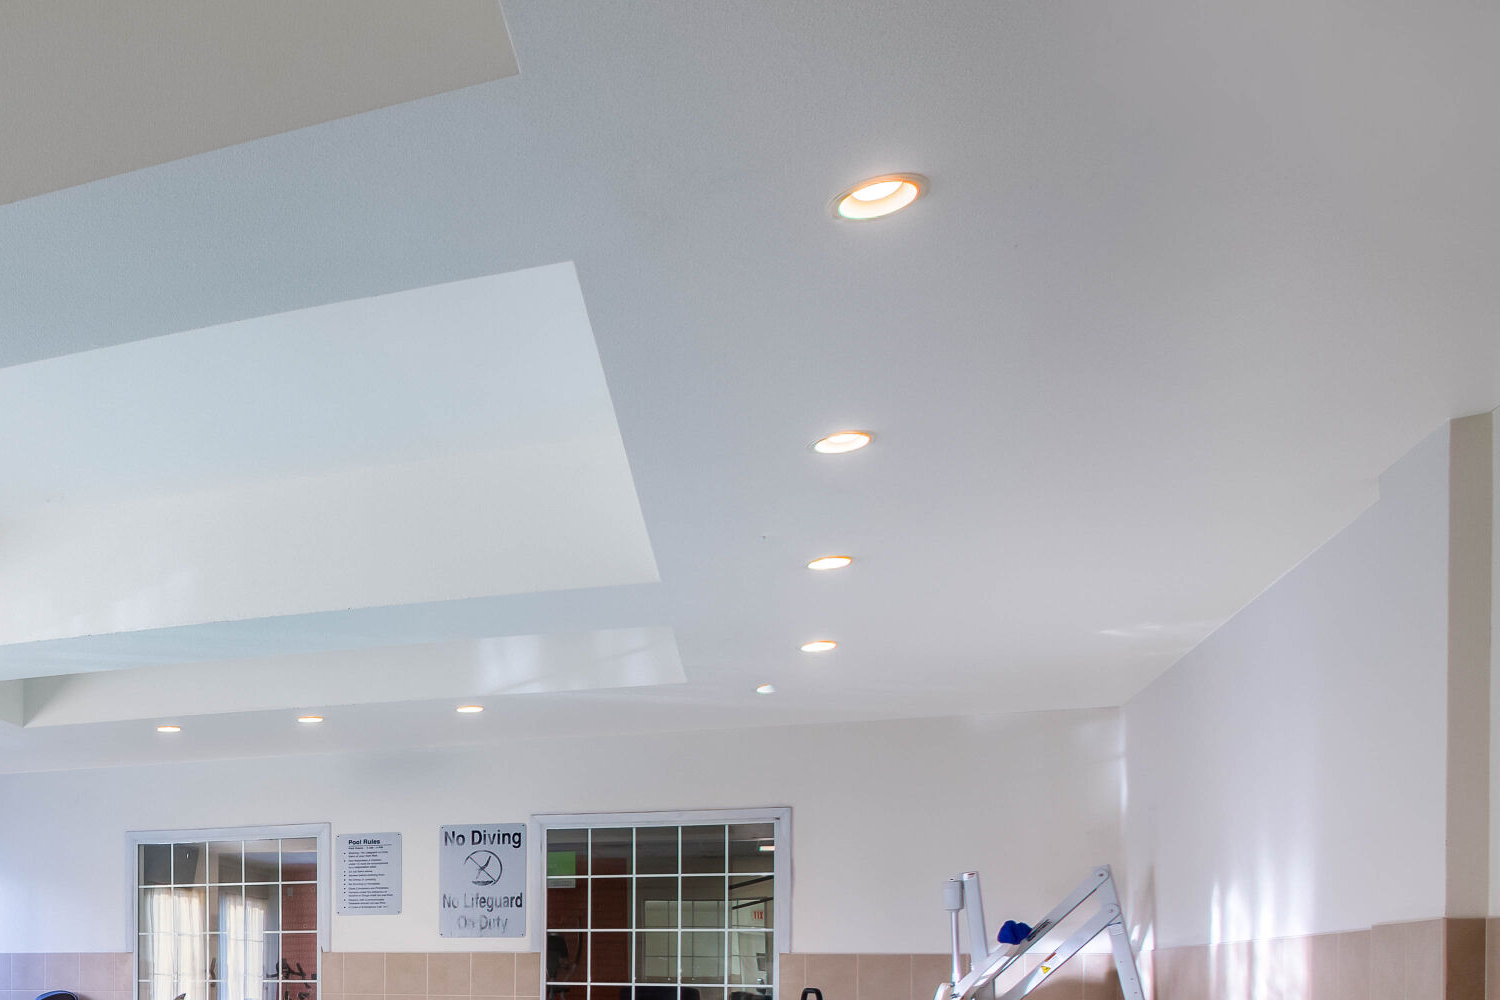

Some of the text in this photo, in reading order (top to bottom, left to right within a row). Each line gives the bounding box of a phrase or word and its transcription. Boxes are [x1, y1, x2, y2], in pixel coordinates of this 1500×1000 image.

[444, 829, 522, 848] No Diving
[442, 892, 523, 912] No Lifeguard
[457, 915, 476, 928] On
